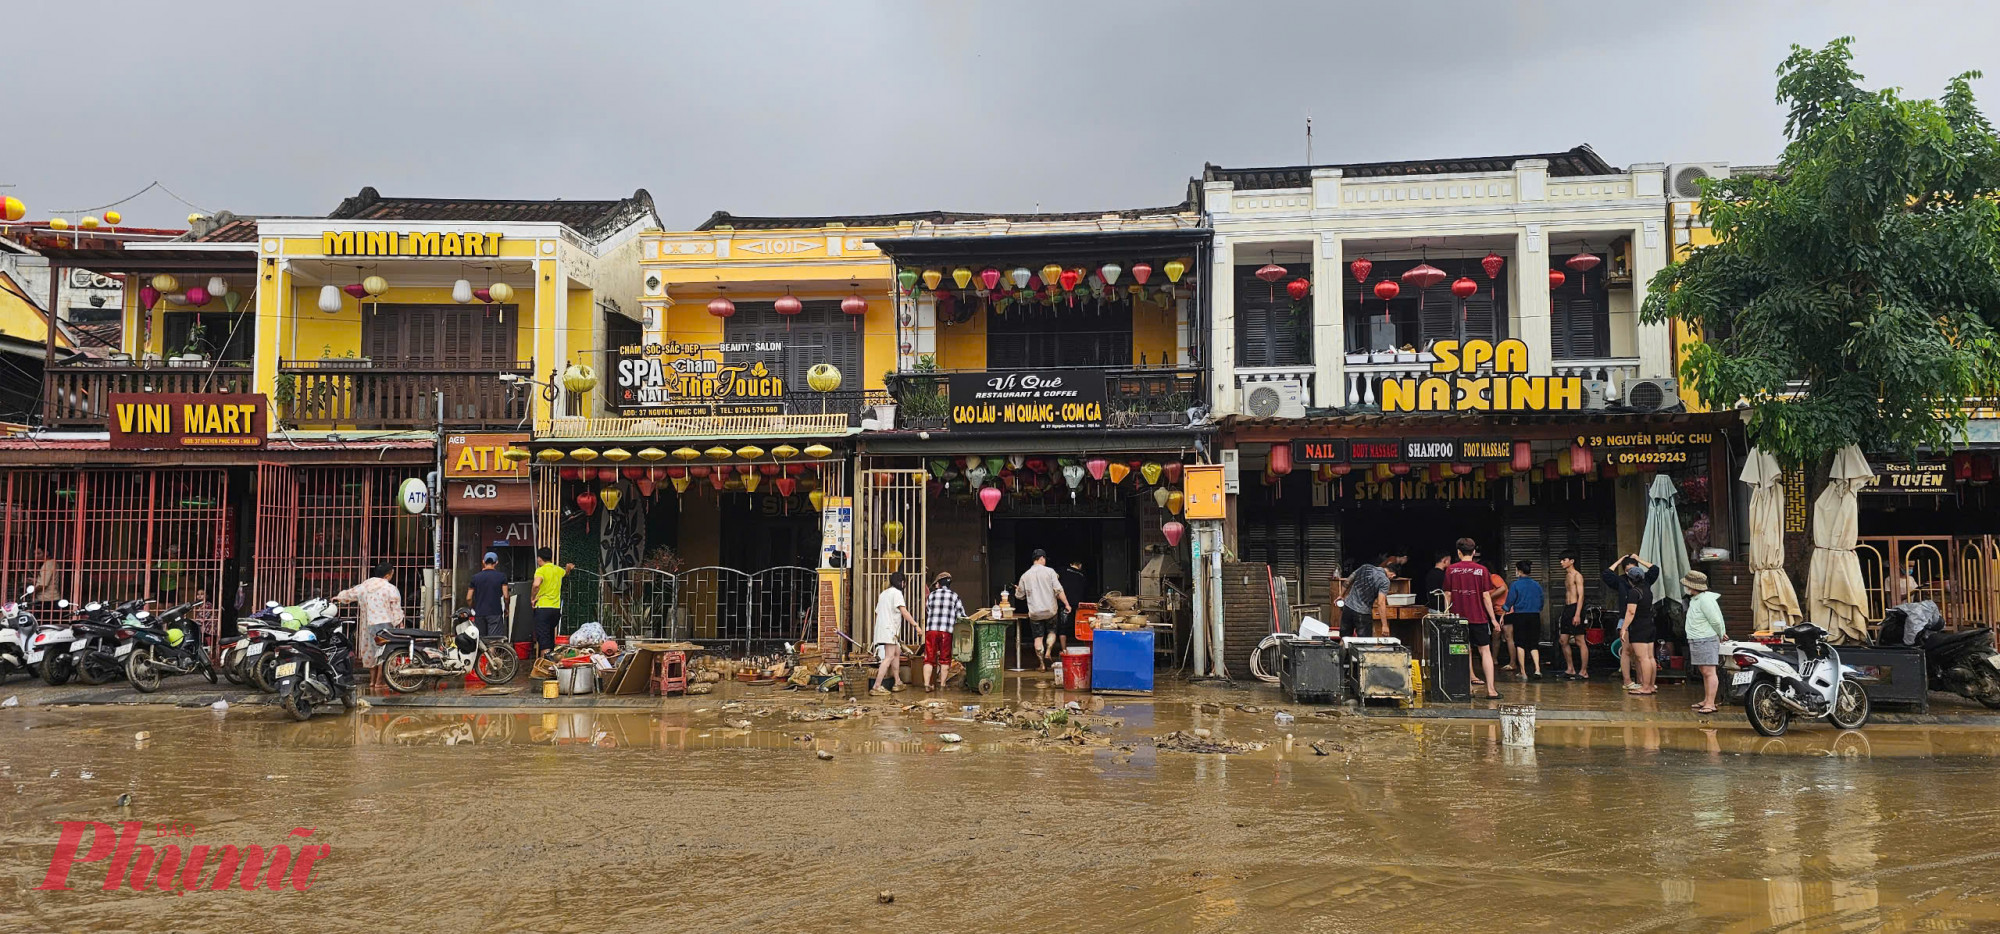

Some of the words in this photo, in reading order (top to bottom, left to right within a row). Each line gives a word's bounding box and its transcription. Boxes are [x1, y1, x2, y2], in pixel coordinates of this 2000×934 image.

[322, 231, 400, 255] MINI
[408, 232, 503, 256] MART
[719, 342, 749, 352] BEAUTY
[754, 342, 782, 351] SALON
[1432, 338, 1528, 373] SPA
[618, 358, 664, 387] SPA
[679, 376, 713, 397] The
[716, 361, 783, 397] Touch
[987, 374, 1017, 390] Vị
[1020, 375, 1064, 389] Quê
[624, 390, 632, 399] &
[637, 389, 670, 402] NAIL
[975, 391, 1032, 399] RESTAURANT
[116, 403, 170, 433] VINI
[184, 404, 256, 434] MART
[639, 408, 647, 416] 37
[953, 405, 975, 423] CAO
[1017, 401, 1054, 423] QUẢNG
[1061, 403, 1085, 422] CƠM
[448, 436, 466, 444] ACB
[1590, 436, 1602, 446] 39
[1606, 432, 1651, 446] NGUYỄN
[1655, 431, 1685, 445] PHÚC
[1689, 433, 1712, 443] CHU
[1305, 443, 1335, 459] NAIL
[1352, 443, 1369, 458] BODY
[1370, 443, 1398, 458] MASSAGE
[1408, 442, 1454, 458] SHAMPOO
[1463, 442, 1480, 457] FOOT
[1481, 442, 1510, 457] MASSAGE
[455, 446, 518, 471] ATM
[1619, 452, 1687, 464] 0914929243
[1886, 463, 1947, 472] Resturant
[408, 492, 427, 503] ATM
[463, 484, 497, 498] ACB
